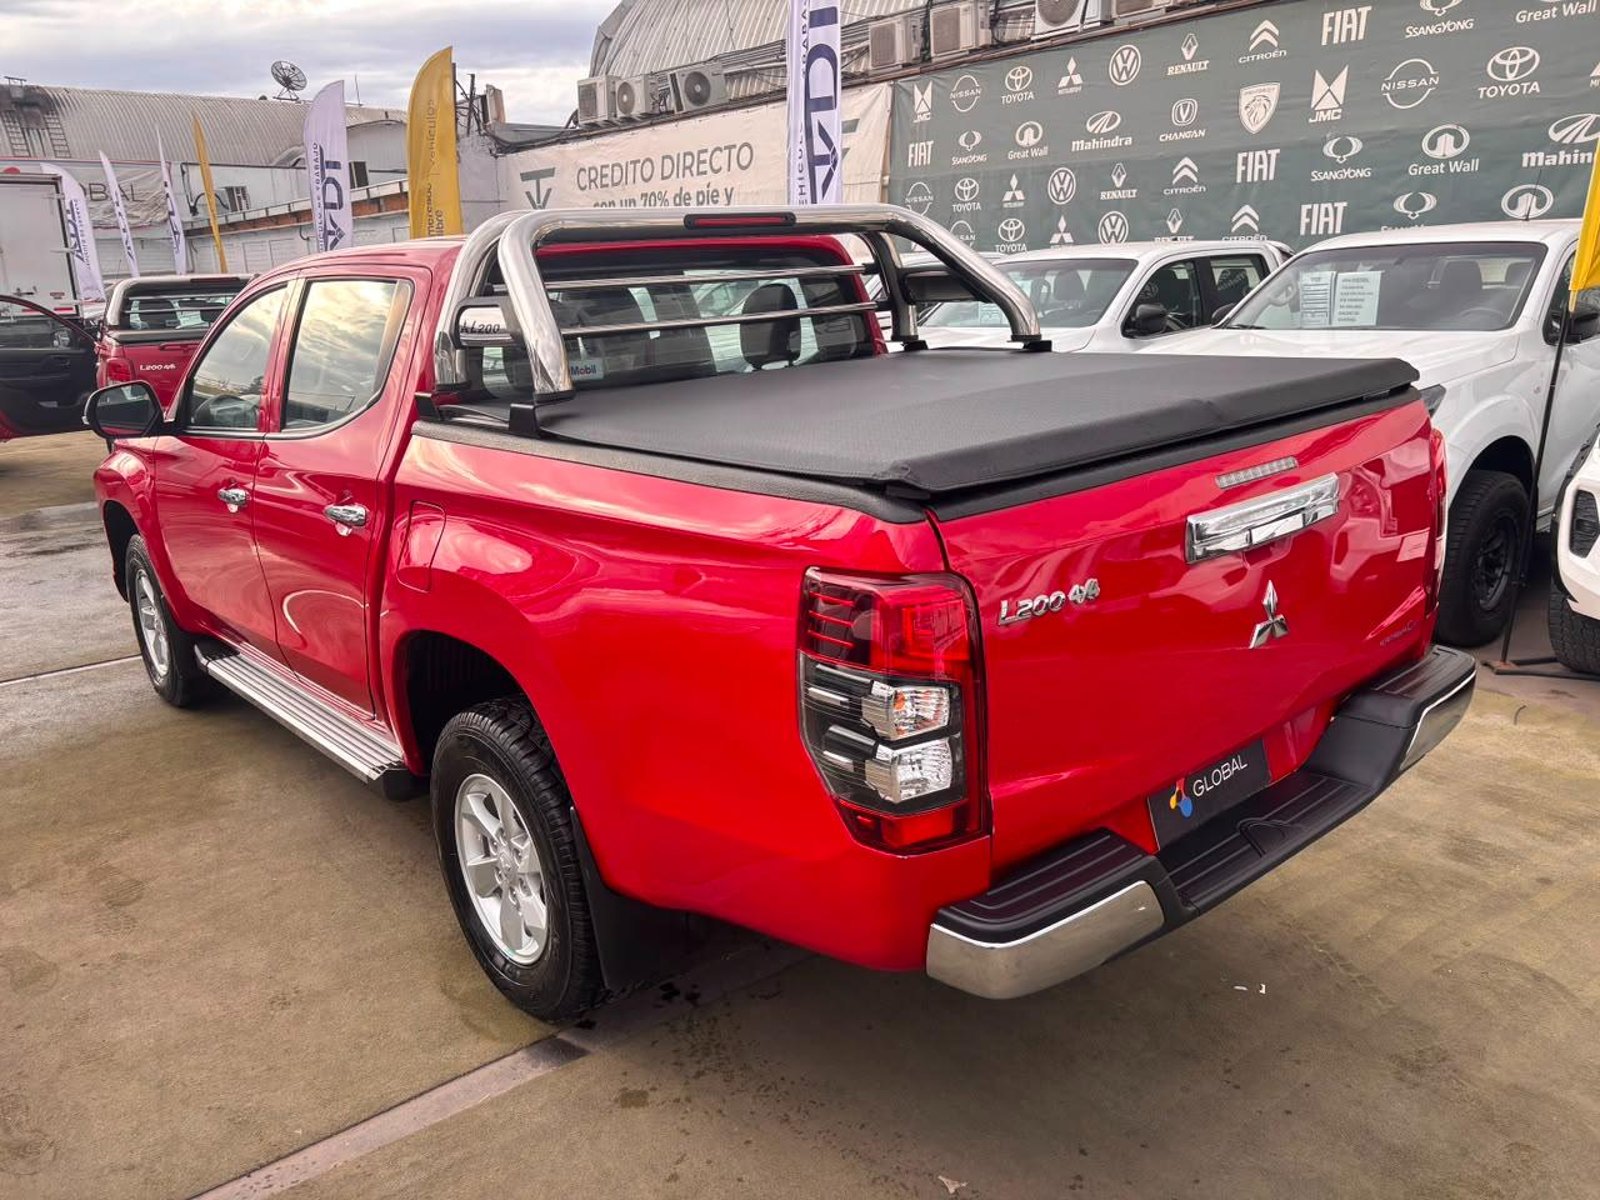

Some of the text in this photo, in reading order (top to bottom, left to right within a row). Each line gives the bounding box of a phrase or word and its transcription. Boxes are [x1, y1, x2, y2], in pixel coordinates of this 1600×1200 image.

[1515, 0, 1598, 24] Great Wall
[1321, 6, 1372, 46] FIAT
[1405, 18, 1475, 38] SSANGYONG
[1166, 60, 1210, 76] RENAULT
[1381, 76, 1440, 91] NISSAN
[1478, 81, 1541, 99] TOYOTA
[949, 88, 982, 99] NISSAN
[1001, 91, 1035, 105] TOYOTA
[1308, 108, 1343, 123] JMC
[1159, 129, 1207, 142] CHANGAN
[1071, 136, 1133, 152] Mahindra
[908, 140, 935, 168] FIAT
[1007, 145, 1049, 160] Great Wall
[1521, 150, 1592, 168] Mahin
[576, 142, 755, 192] CREDITO DIRECTO
[1236, 148, 1281, 184] FIAT
[1408, 158, 1480, 176] Great Wall
[1310, 167, 1373, 182] SSANGYONG
[640, 190, 670, 208] 70%
[674, 187, 695, 207] de
[723, 185, 735, 207] y
[1100, 189, 1138, 200] RENAULT
[952, 202, 982, 213] TOYOTA
[1300, 202, 1348, 236] FIAT
[994, 243, 1028, 252] TOYOTA
[469, 320, 500, 335] L200
[570, 364, 597, 376] Mobil
[998, 591, 1066, 626] L200
[1192, 754, 1249, 797] GLOBAL
